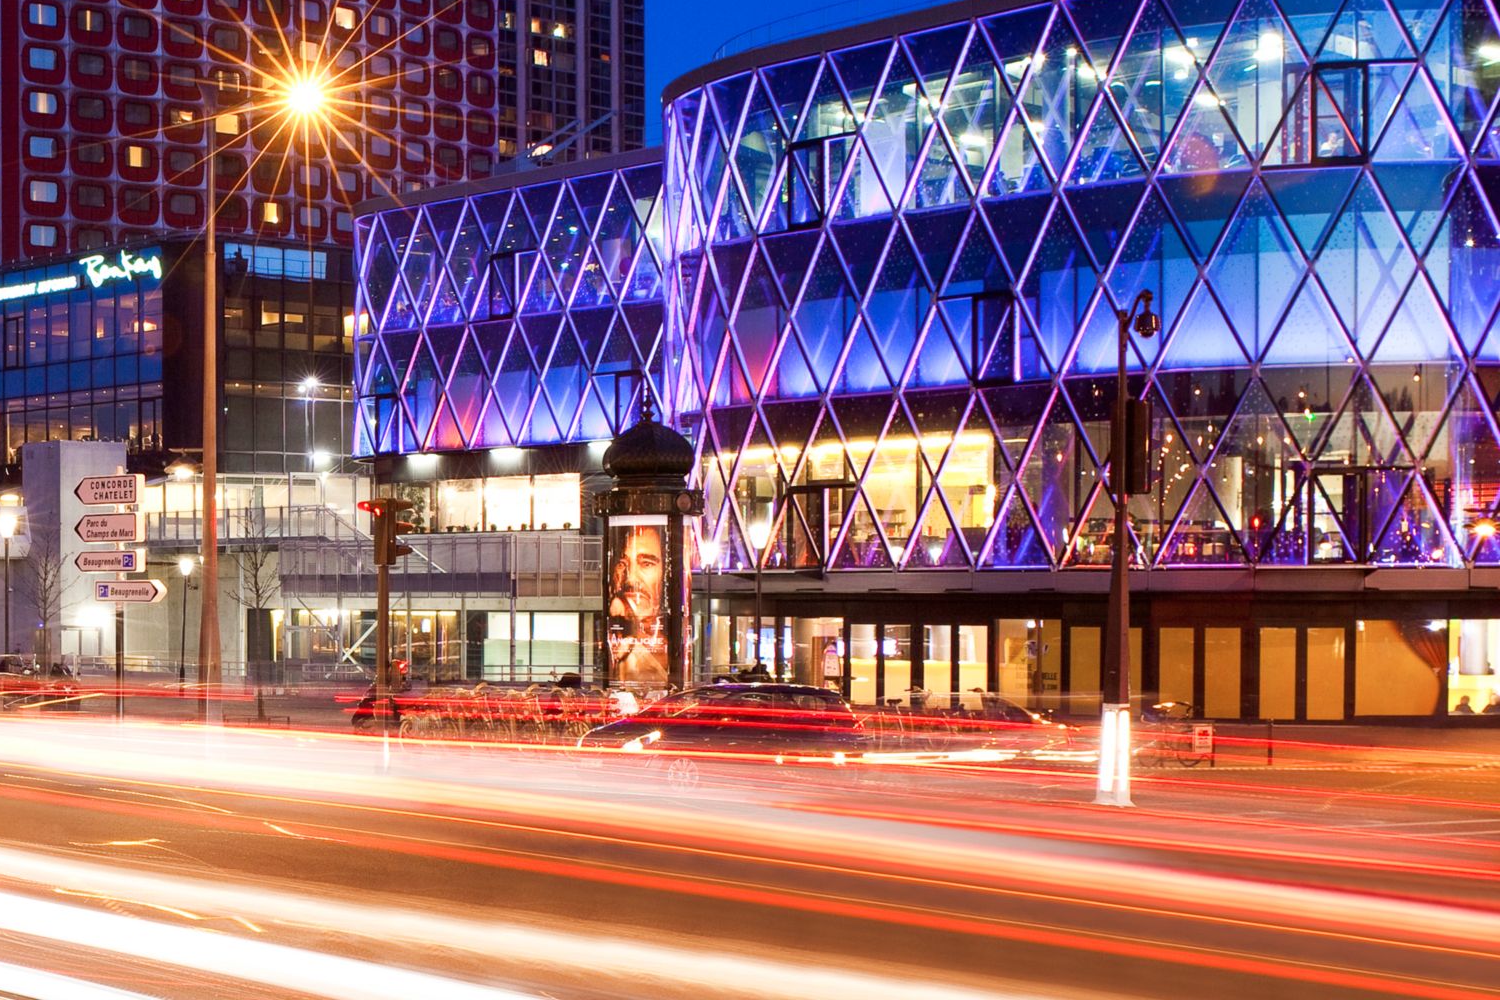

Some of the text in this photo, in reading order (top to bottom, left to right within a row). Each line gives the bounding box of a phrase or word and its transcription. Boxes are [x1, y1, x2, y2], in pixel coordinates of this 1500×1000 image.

[90, 480, 133, 490] CONCORDE
[94, 490, 133, 500] CHATELET
[86, 518, 108, 528] Parc du
[86, 528, 134, 539] Champs de Mars
[83, 557, 121, 567] Beaugrenelle
[110, 587, 149, 598] Beaugrenelle
